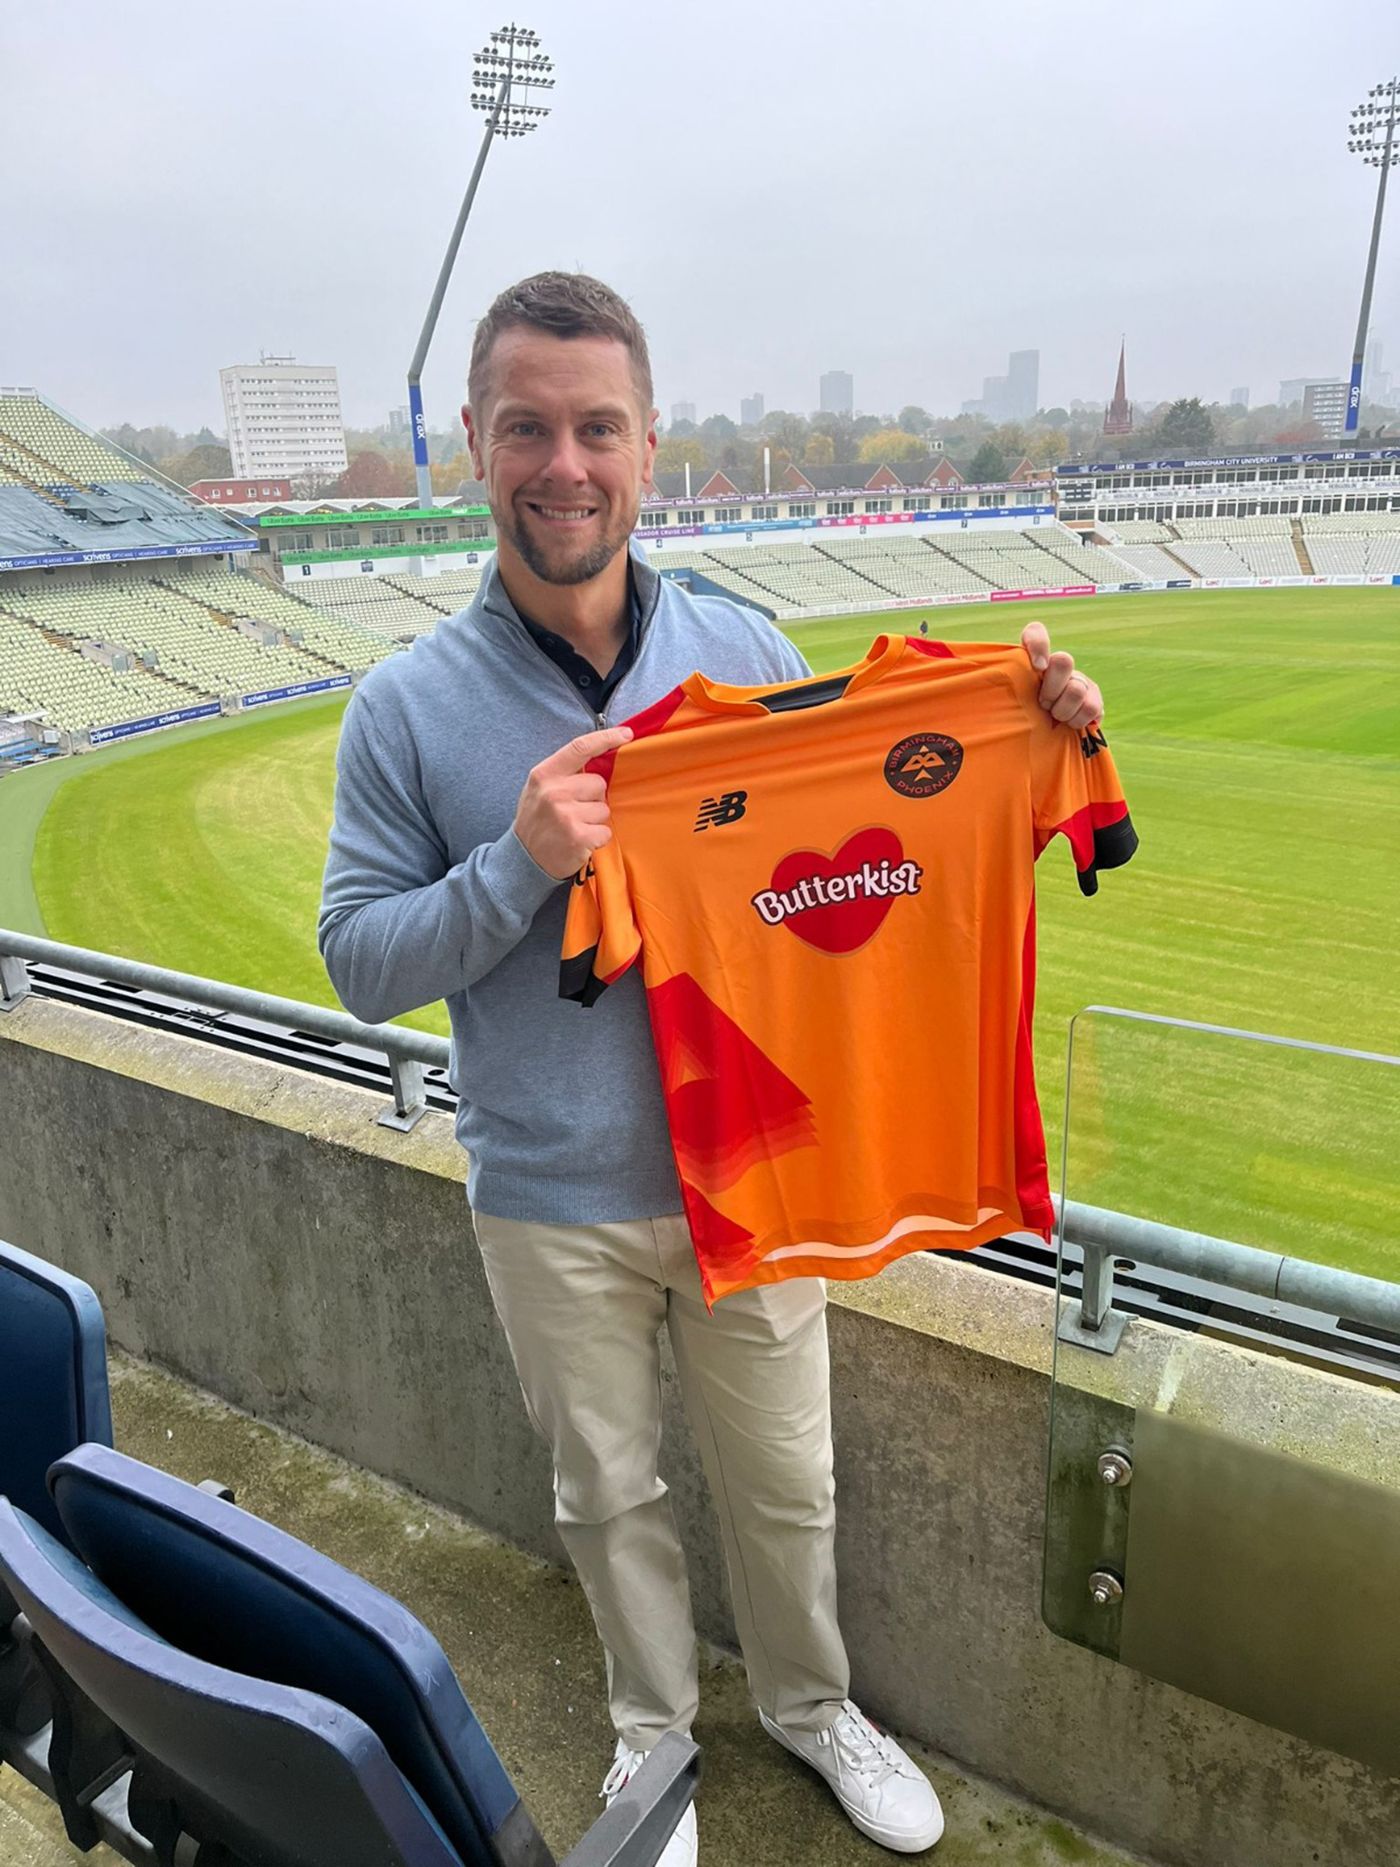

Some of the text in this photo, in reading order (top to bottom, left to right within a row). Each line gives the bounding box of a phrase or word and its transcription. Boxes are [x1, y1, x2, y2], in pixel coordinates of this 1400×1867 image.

[1350, 386, 1360, 408] drax
[1184, 456, 1278, 468] BIRMINGHAM CITY UNIVERSITY
[896, 770, 953, 794] PHOENIX
[753, 859, 921, 925] Butterkist
